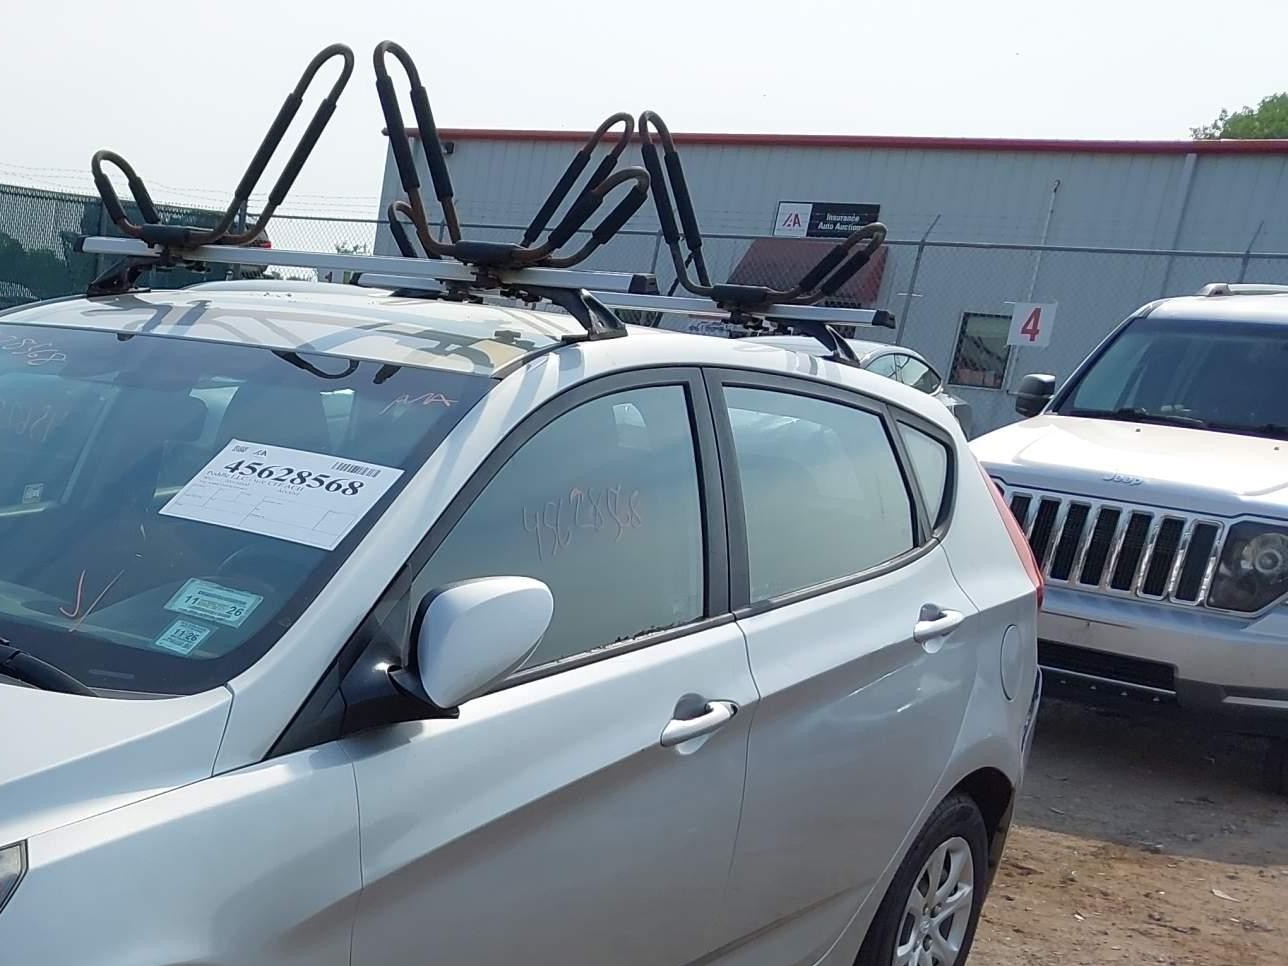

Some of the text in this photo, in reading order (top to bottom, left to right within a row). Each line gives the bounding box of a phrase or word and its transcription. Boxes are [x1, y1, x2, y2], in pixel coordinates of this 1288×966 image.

[826, 212, 861, 222] Insurance
[817, 222, 834, 230] Auto
[1020, 307, 1042, 342] 4
[224, 459, 365, 496] 45628568
[1103, 472, 1144, 487] Jeep
[184, 595, 200, 605] 11
[225, 605, 245, 617] 26
[174, 628, 185, 637] 11
[185, 632, 199, 642] 26
